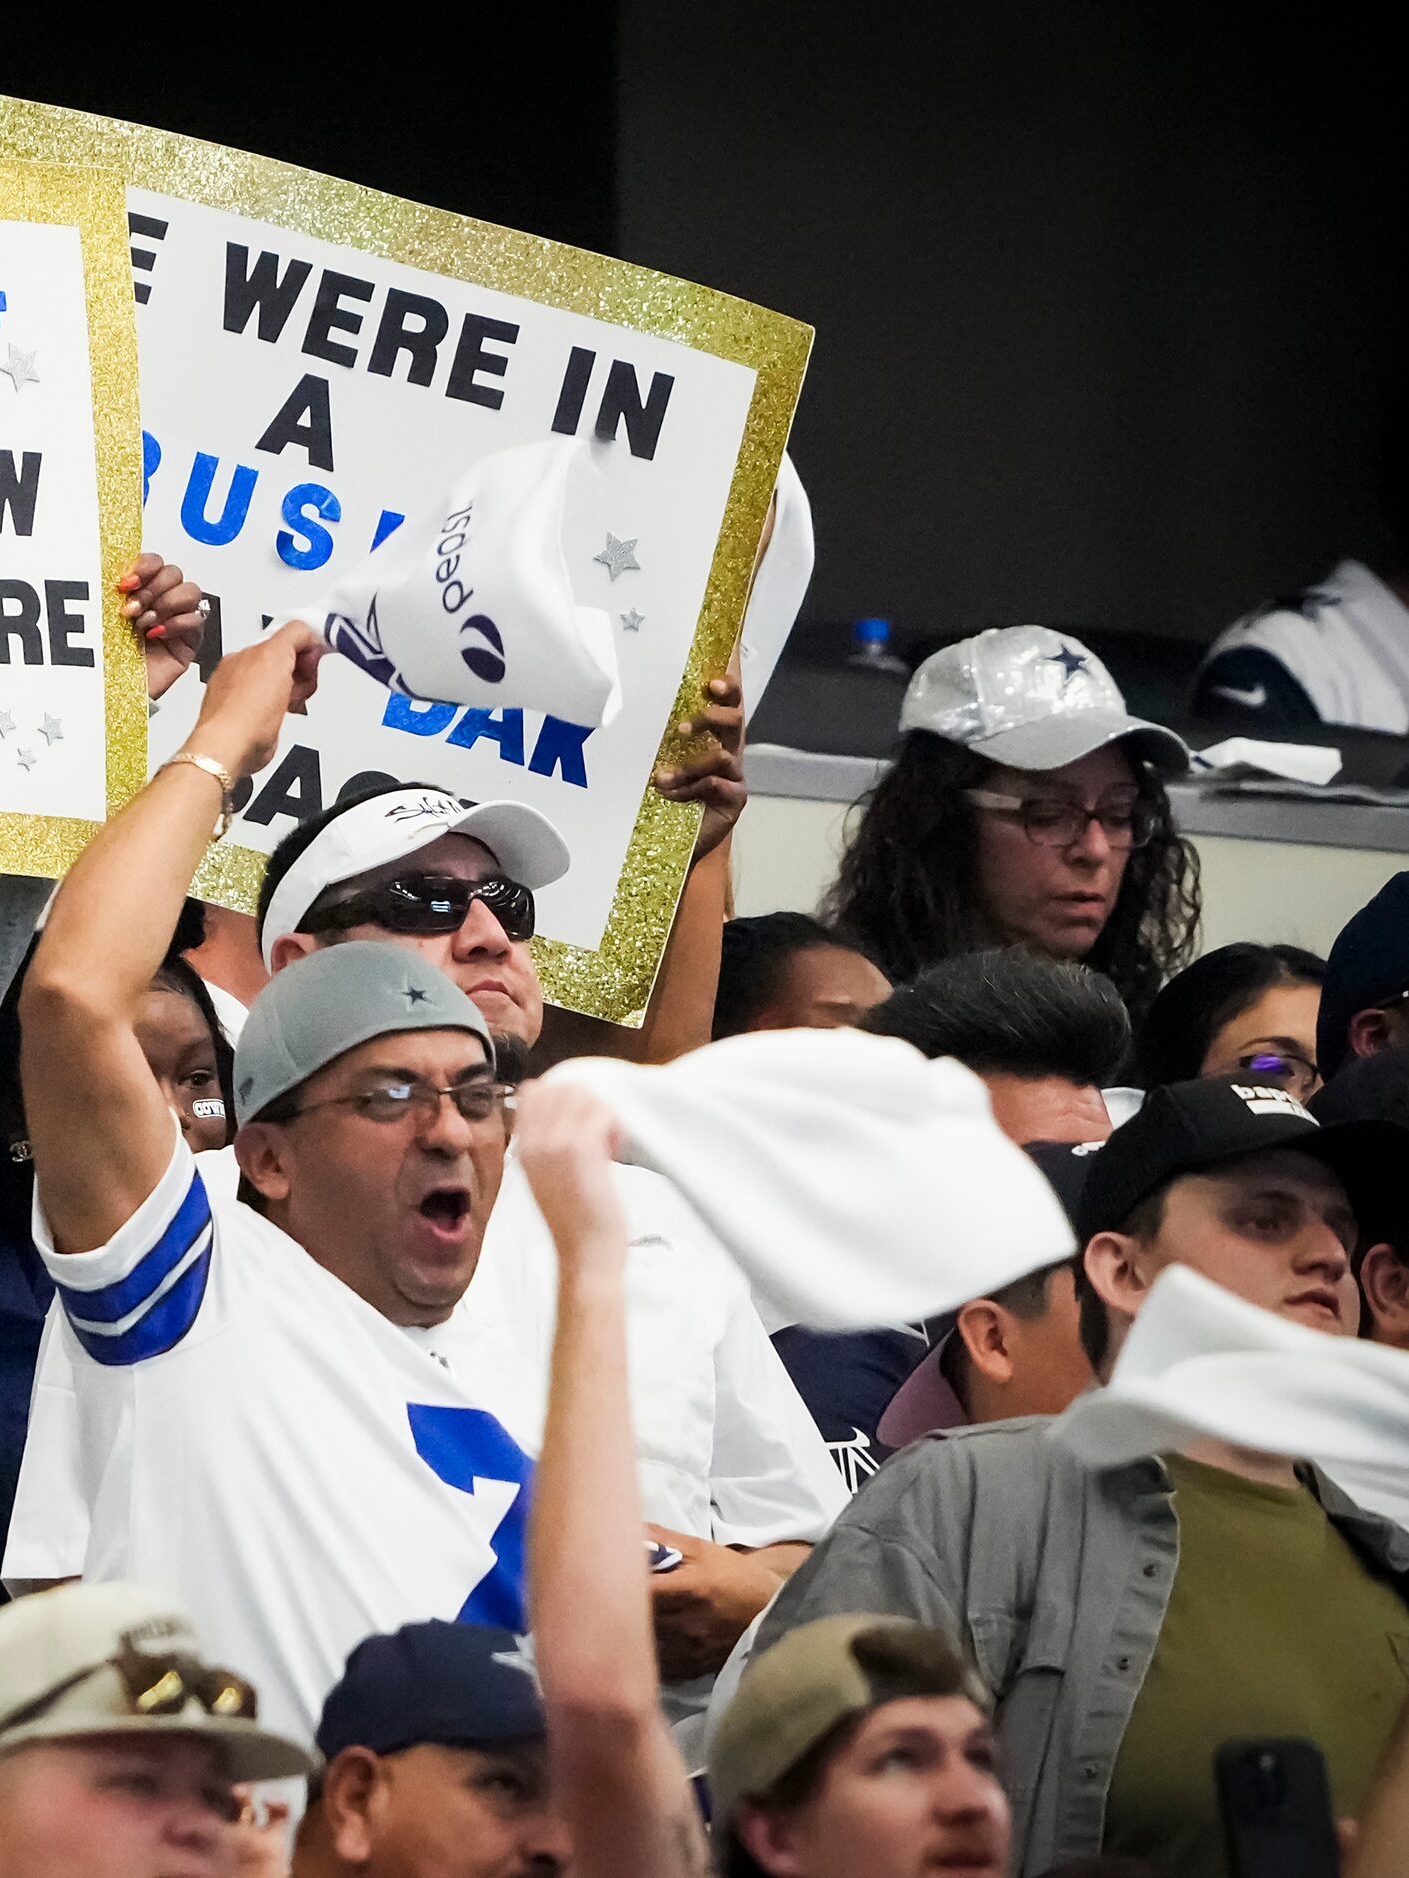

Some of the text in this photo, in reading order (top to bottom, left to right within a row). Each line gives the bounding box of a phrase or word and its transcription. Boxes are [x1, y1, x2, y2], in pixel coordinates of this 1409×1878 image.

[223, 241, 520, 411] WERE
[550, 345, 676, 462] IN
[254, 373, 334, 473] A
[142, 431, 406, 572] US
